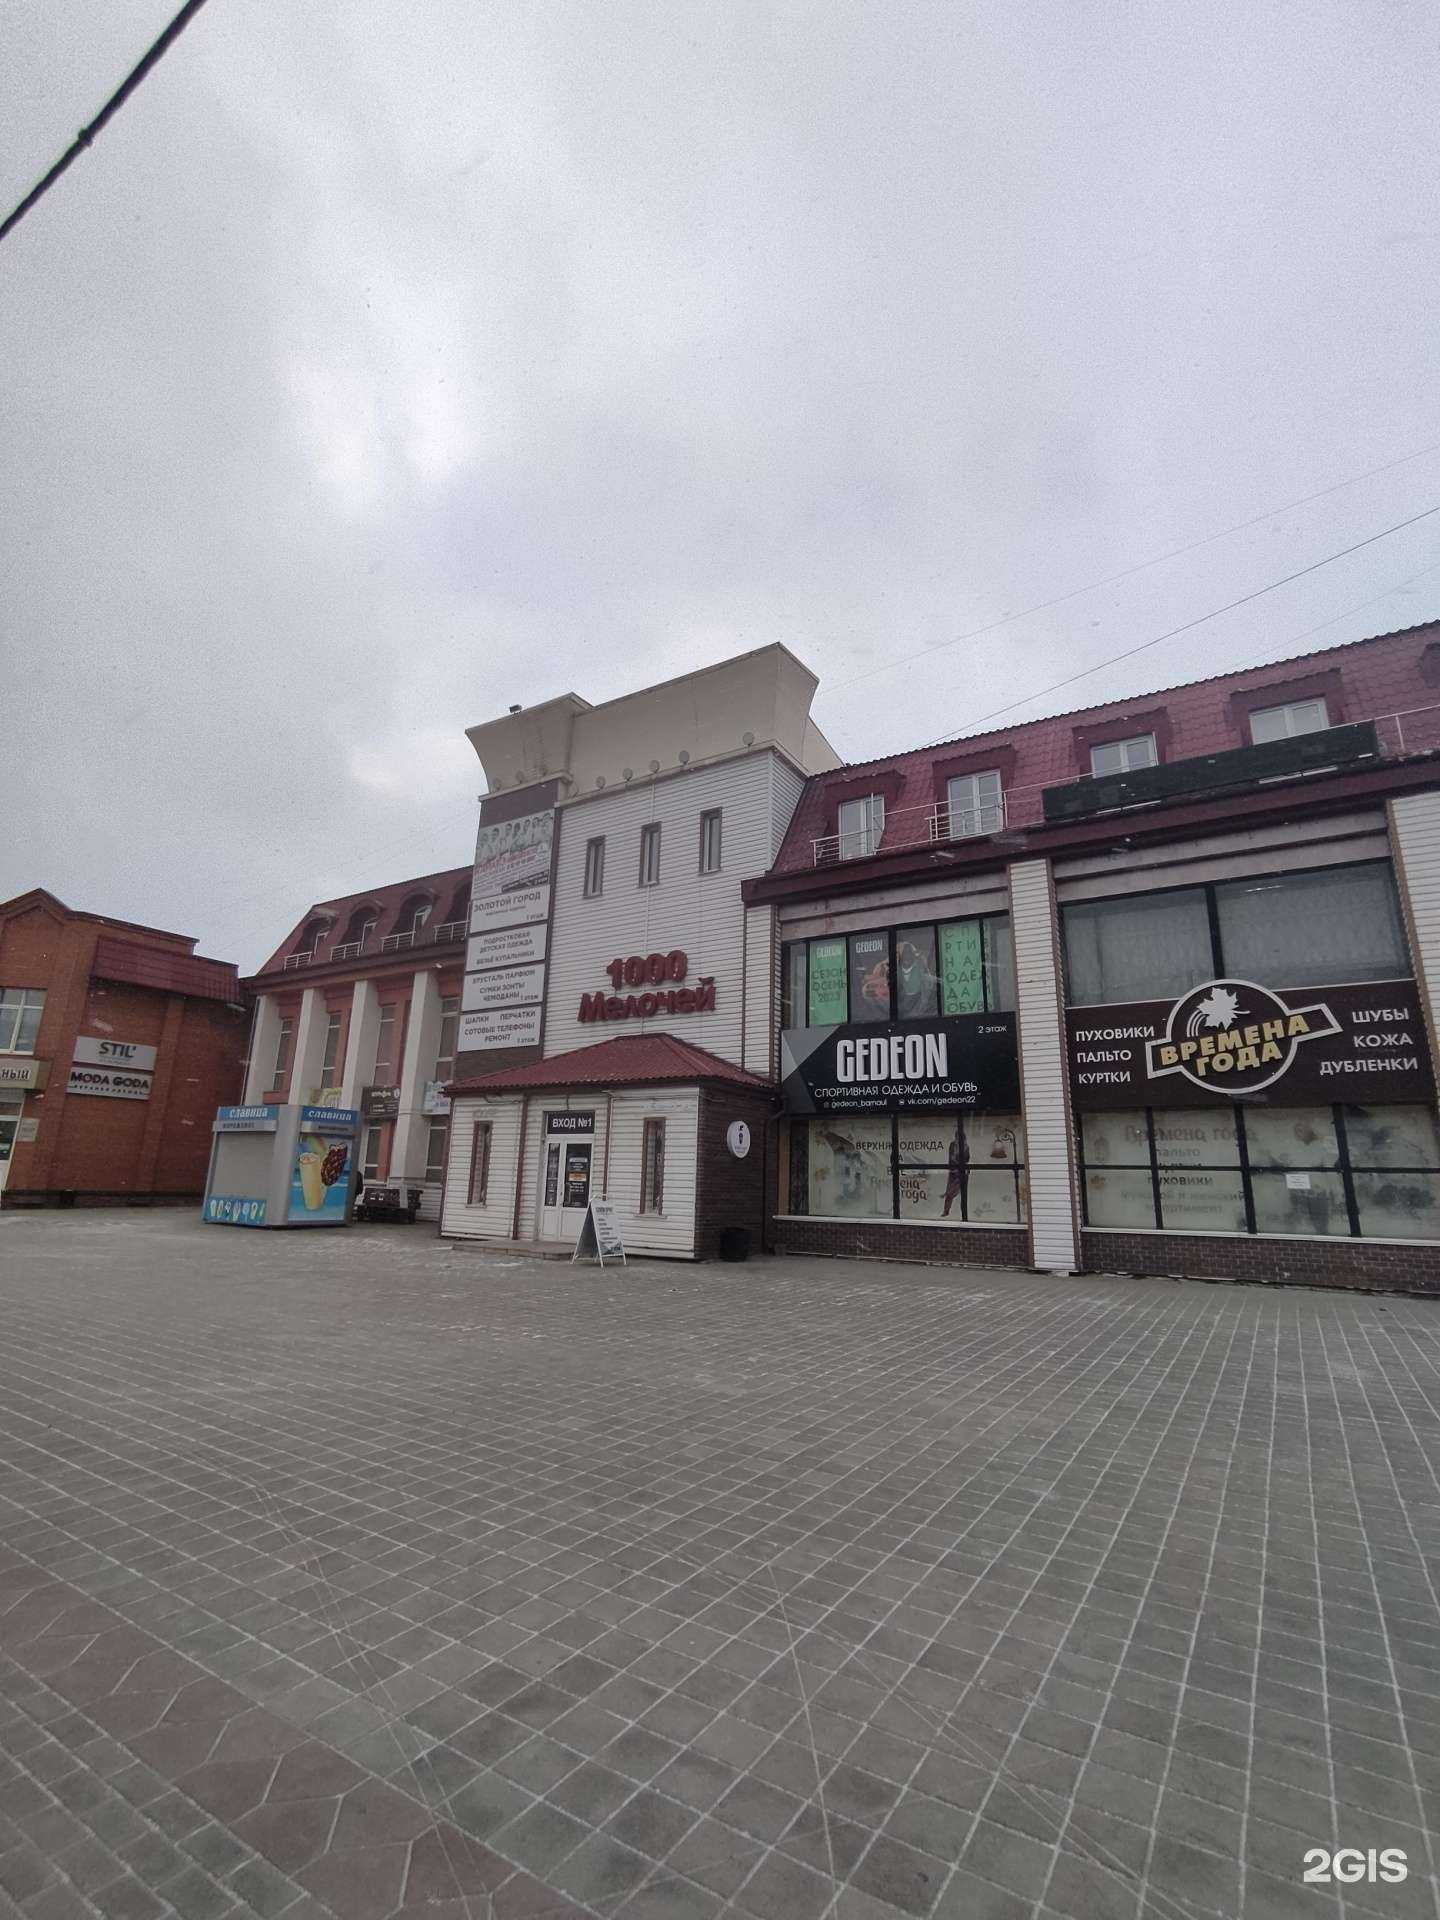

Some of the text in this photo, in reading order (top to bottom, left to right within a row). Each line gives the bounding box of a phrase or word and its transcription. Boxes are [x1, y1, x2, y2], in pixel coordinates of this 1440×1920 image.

[474, 896, 511, 912] ЗОЛОТОЙ
[512, 892, 541, 904] ГОРОД
[855, 939, 883, 953] GEDEON
[606, 950, 688, 991] 1000
[577, 977, 716, 1023] Мелочей
[465, 1011, 535, 1024] ШАПКИ ПЕРЧАТКИ
[1352, 1008, 1410, 1023] ШУБЫ
[464, 1023, 535, 1036] СОТОВЫЕ ТЕЛЕФОНЫ
[978, 1025, 1007, 1034] 2 этаж
[1076, 1026, 1155, 1042] ПУХОВИКИ
[485, 1034, 511, 1043] РЕМОНТ
[1160, 1014, 1310, 1066] ВРЕМЕНА
[1353, 1032, 1413, 1048] КОЖА
[836, 1033, 948, 1082] GEDEON
[1076, 1050, 1132, 1063] ПАЛЬТО
[1196, 1041, 1283, 1077] ГОДА
[0, 1067, 30, 1080] НЫЙ
[1319, 1057, 1418, 1076] ДУБЛЕНКИ
[71, 1071, 110, 1085] MODA
[113, 1077, 149, 1090] GODA
[1078, 1071, 1131, 1084] КУРТКИ
[814, 1082, 978, 1098] СПОРТИВНАЯ ОДЕЖДА И ОБУВЬ
[907, 1096, 976, 1106] vk.com/gedeon22
[552, 1117, 592, 1129] ВХОД №1
[899, 1141, 944, 1151] ОДЕЖДА
